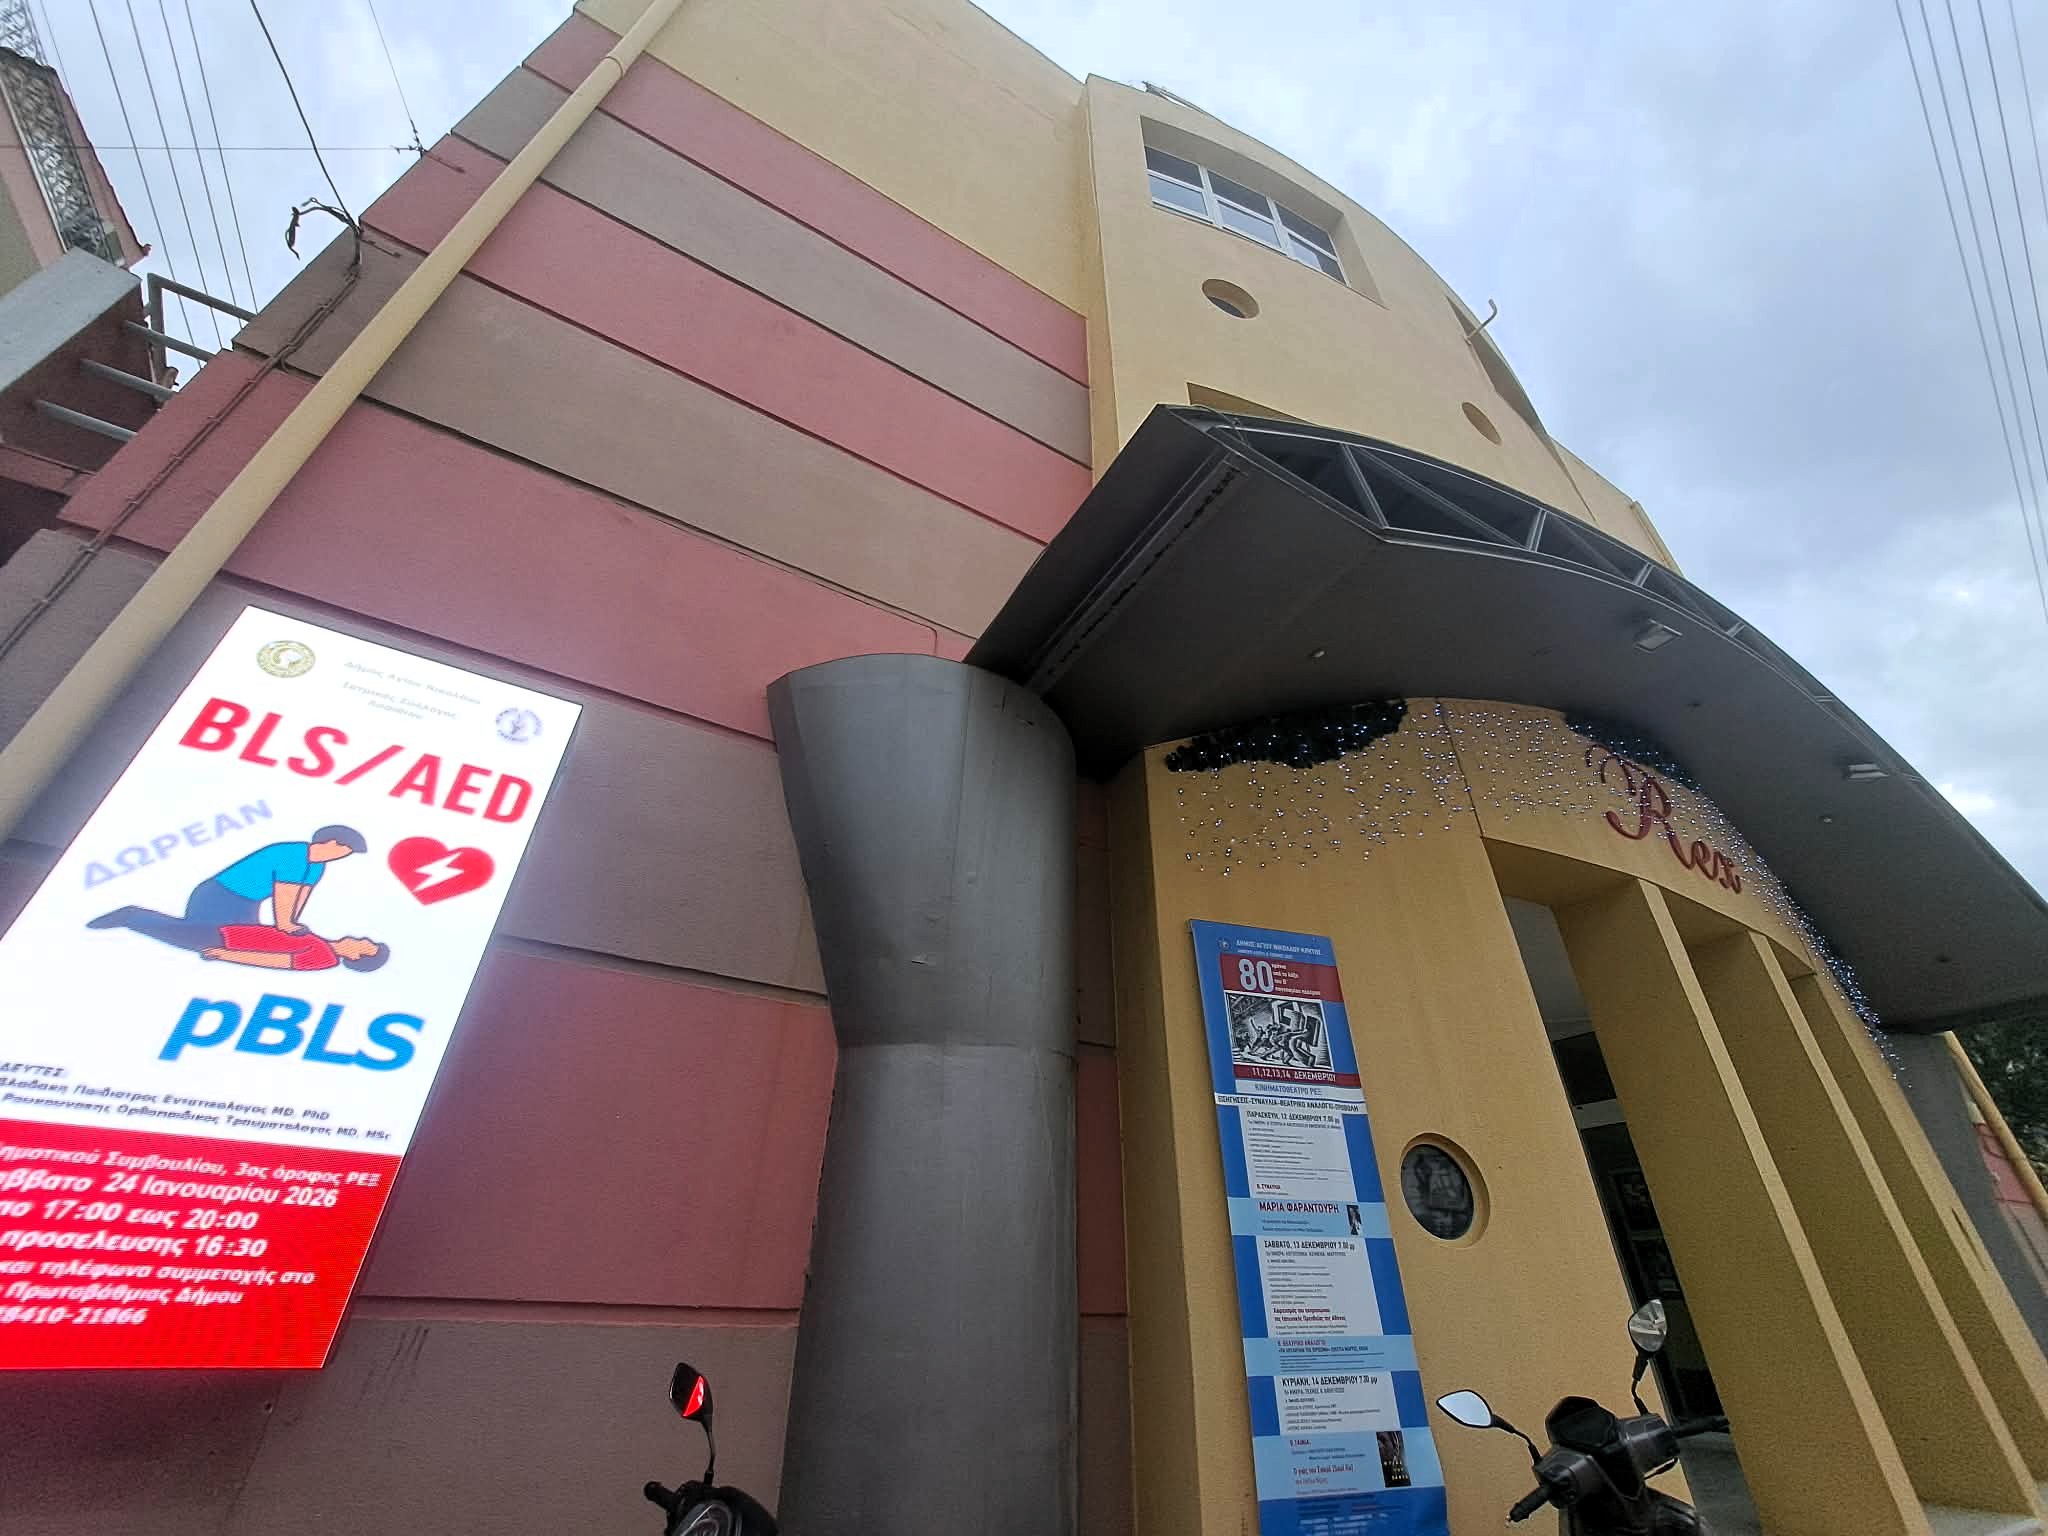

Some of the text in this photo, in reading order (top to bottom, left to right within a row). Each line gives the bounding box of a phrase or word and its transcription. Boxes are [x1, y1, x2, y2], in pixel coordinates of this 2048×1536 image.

[179, 697, 534, 825] BLS/AED
[82, 799, 274, 891] ΔΩΡΕΑΝ
[1238, 958, 1275, 993] 80
[158, 993, 427, 1072] pBLS
[1294, 1070, 1337, 1083] ΔΕΚΕΜΒΡΙΟΥ
[235, 1162, 269, 1181] 3ος
[346, 1171, 383, 1189] ΡΕΞ
[103, 1172, 138, 1194] 24
[141, 1174, 279, 1206] Ιανουαρίου
[283, 1186, 339, 1209] 2026
[43, 1199, 124, 1223] 17:00
[183, 1207, 260, 1232] 20:00
[1258, 1201, 1340, 1215] ΜΑΡΙΑ ΦΑΡΑΝΤΟΥΡΗ
[194, 1235, 269, 1259] 16:30
[1301, 1240, 1338, 1251] ΔΕΚΕΜΒΡΙΟΥ
[279, 1270, 316, 1286] στο
[1320, 1376, 1358, 1386] ΔΕΚΕΜΒΡΙΟΥ
